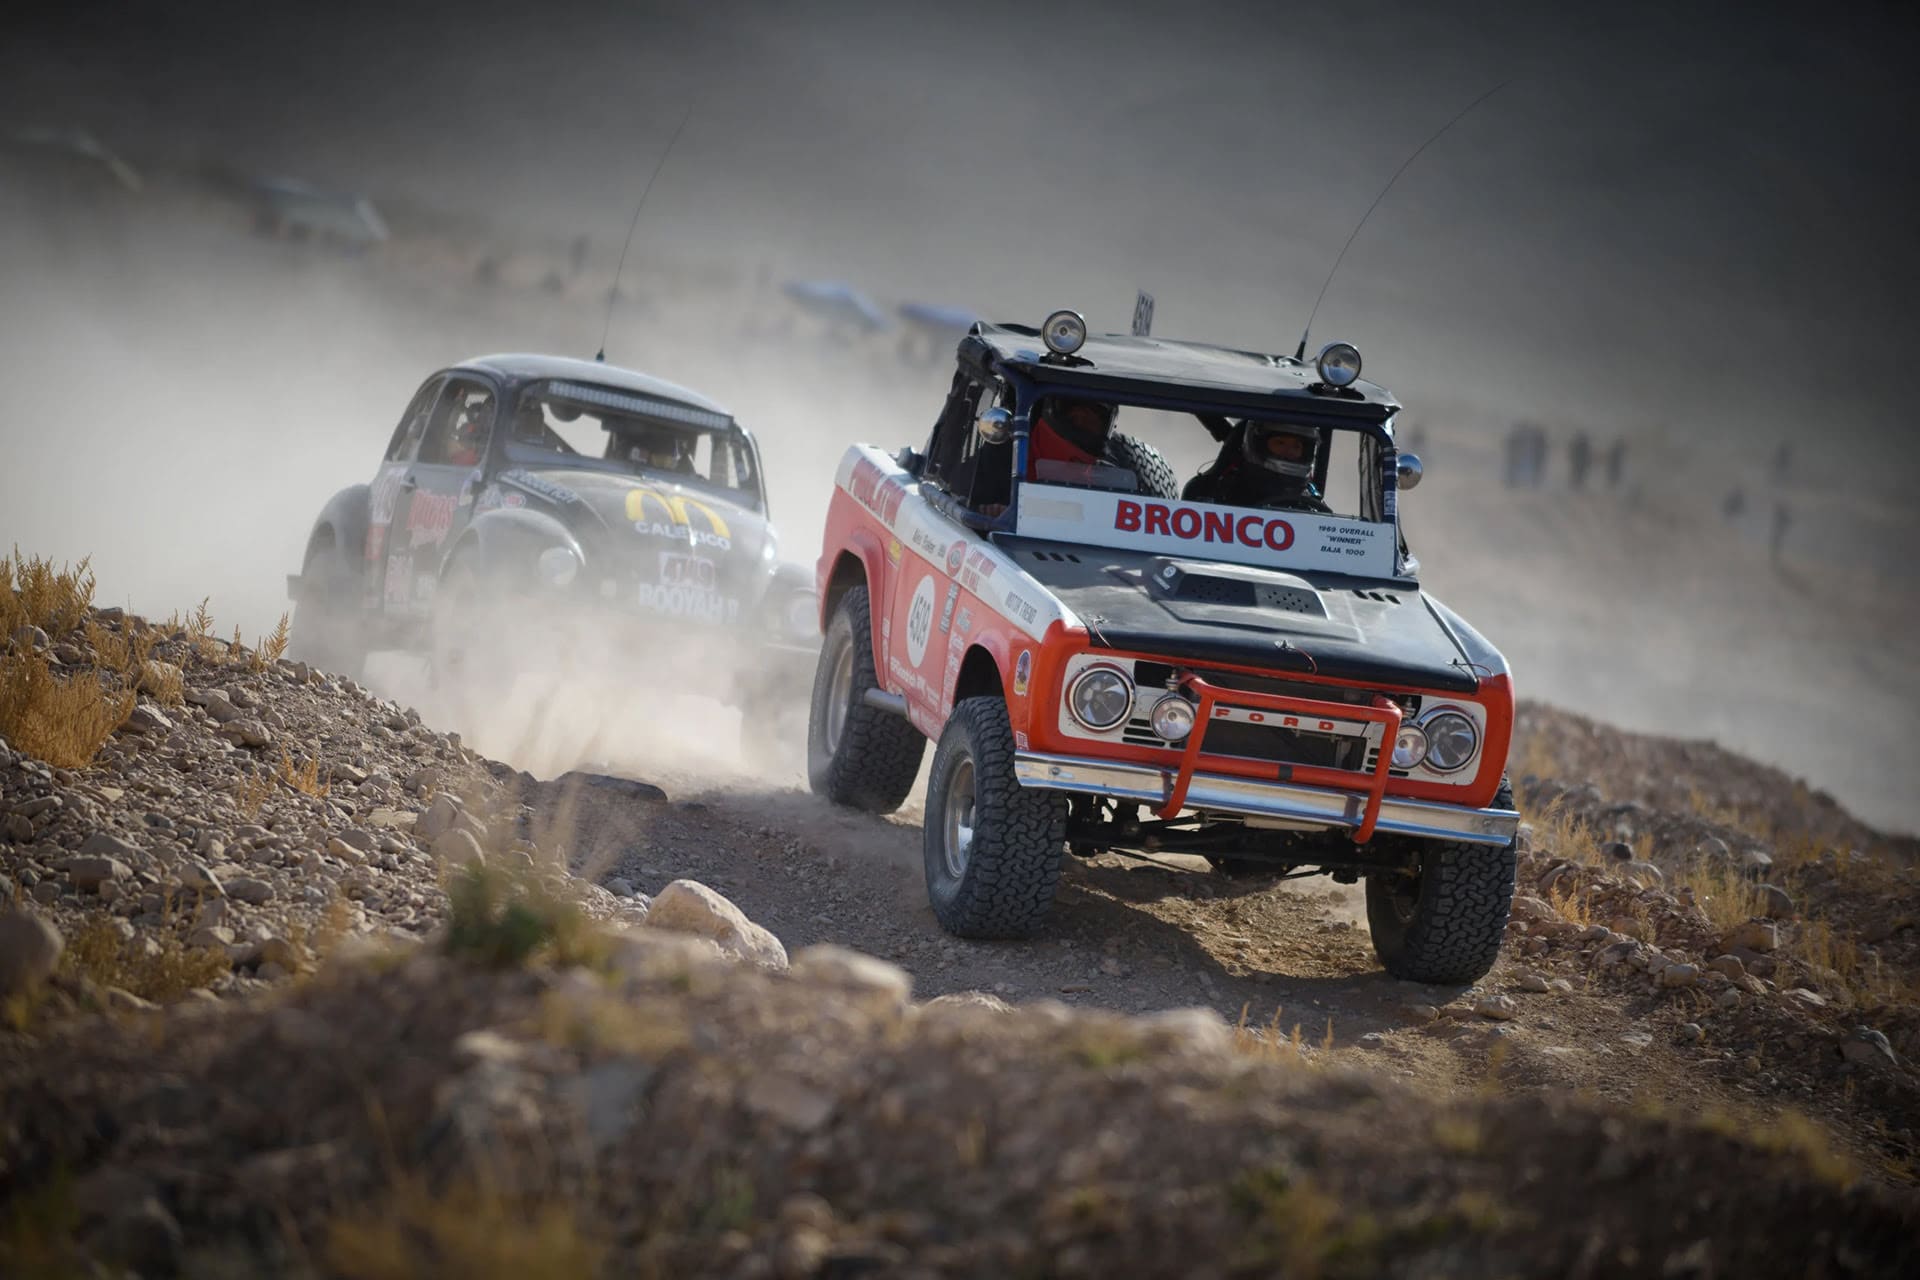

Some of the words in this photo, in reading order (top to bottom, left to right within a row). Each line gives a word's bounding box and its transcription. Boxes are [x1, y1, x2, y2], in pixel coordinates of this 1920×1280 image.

[1114, 499, 1295, 551] BRONCO
[1319, 525, 1337, 533] 1969
[1339, 527, 1375, 537] OVERALL
[1320, 545, 1341, 554] BAJA
[1345, 548, 1365, 557] 1000
[1215, 708, 1335, 731] FORD
